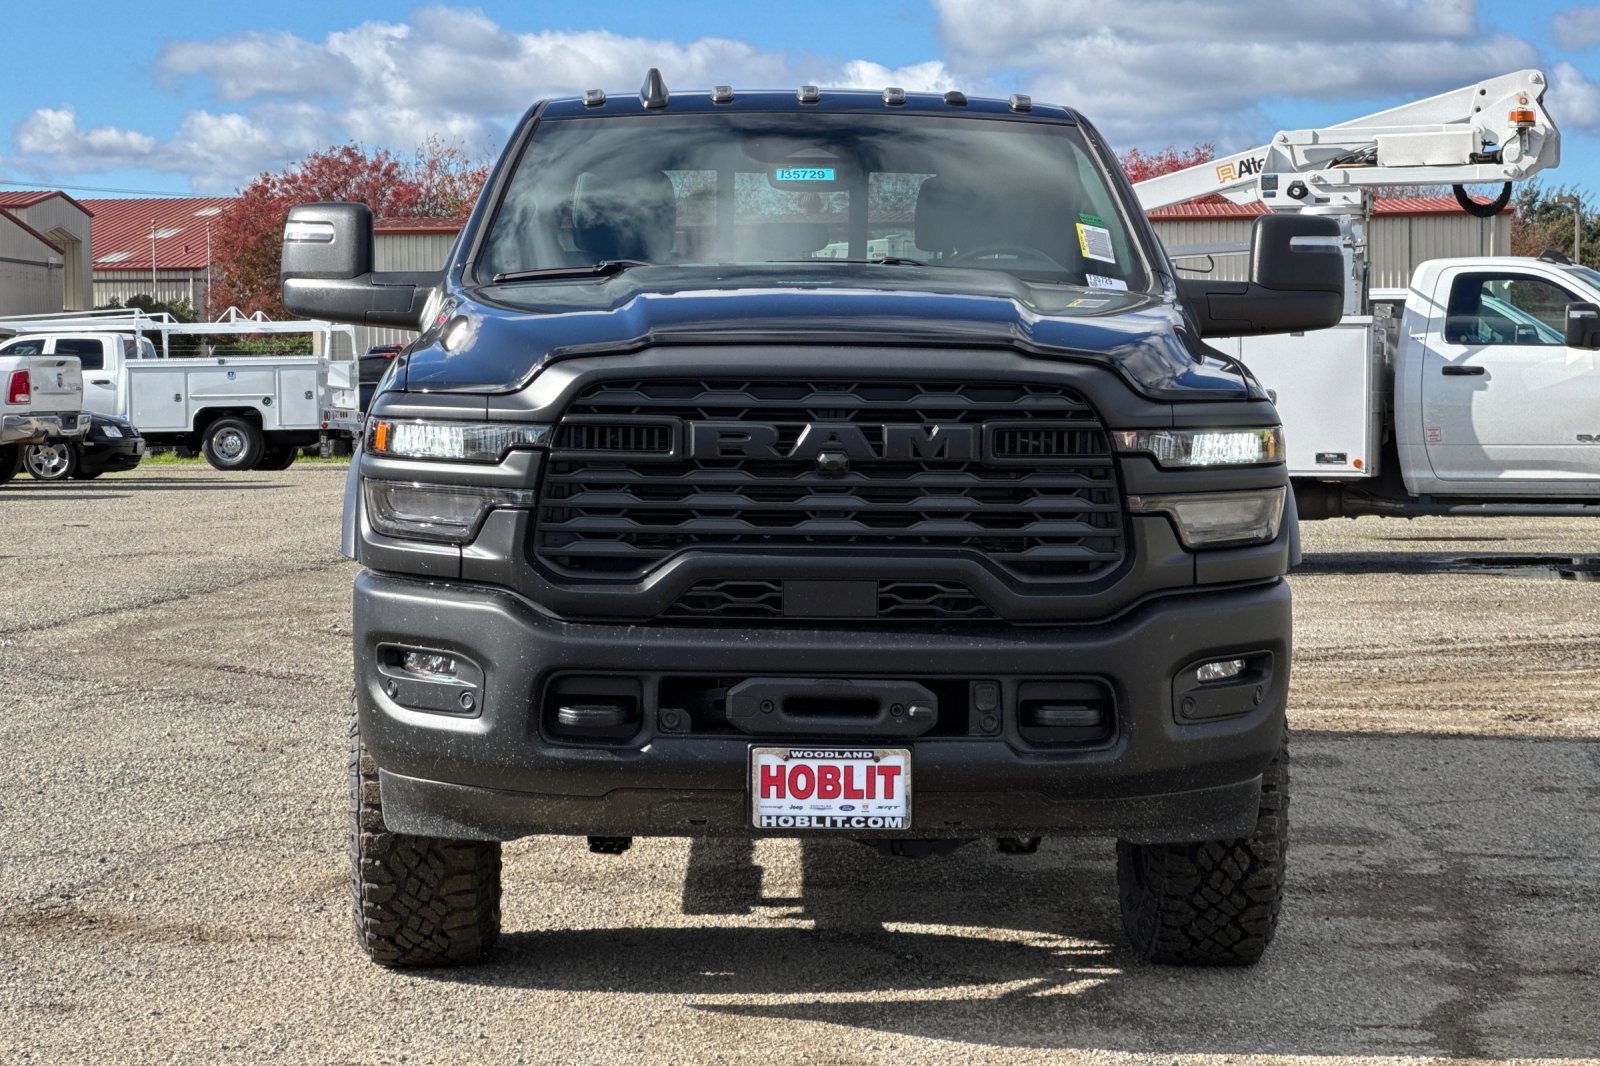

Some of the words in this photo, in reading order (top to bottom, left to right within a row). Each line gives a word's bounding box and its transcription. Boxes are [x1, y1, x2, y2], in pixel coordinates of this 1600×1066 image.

[689, 421, 982, 461] RAM
[790, 751, 873, 759] WOODLAND
[760, 764, 902, 800] HOBLIT
[761, 816, 903, 828] HOBLIT.COM
